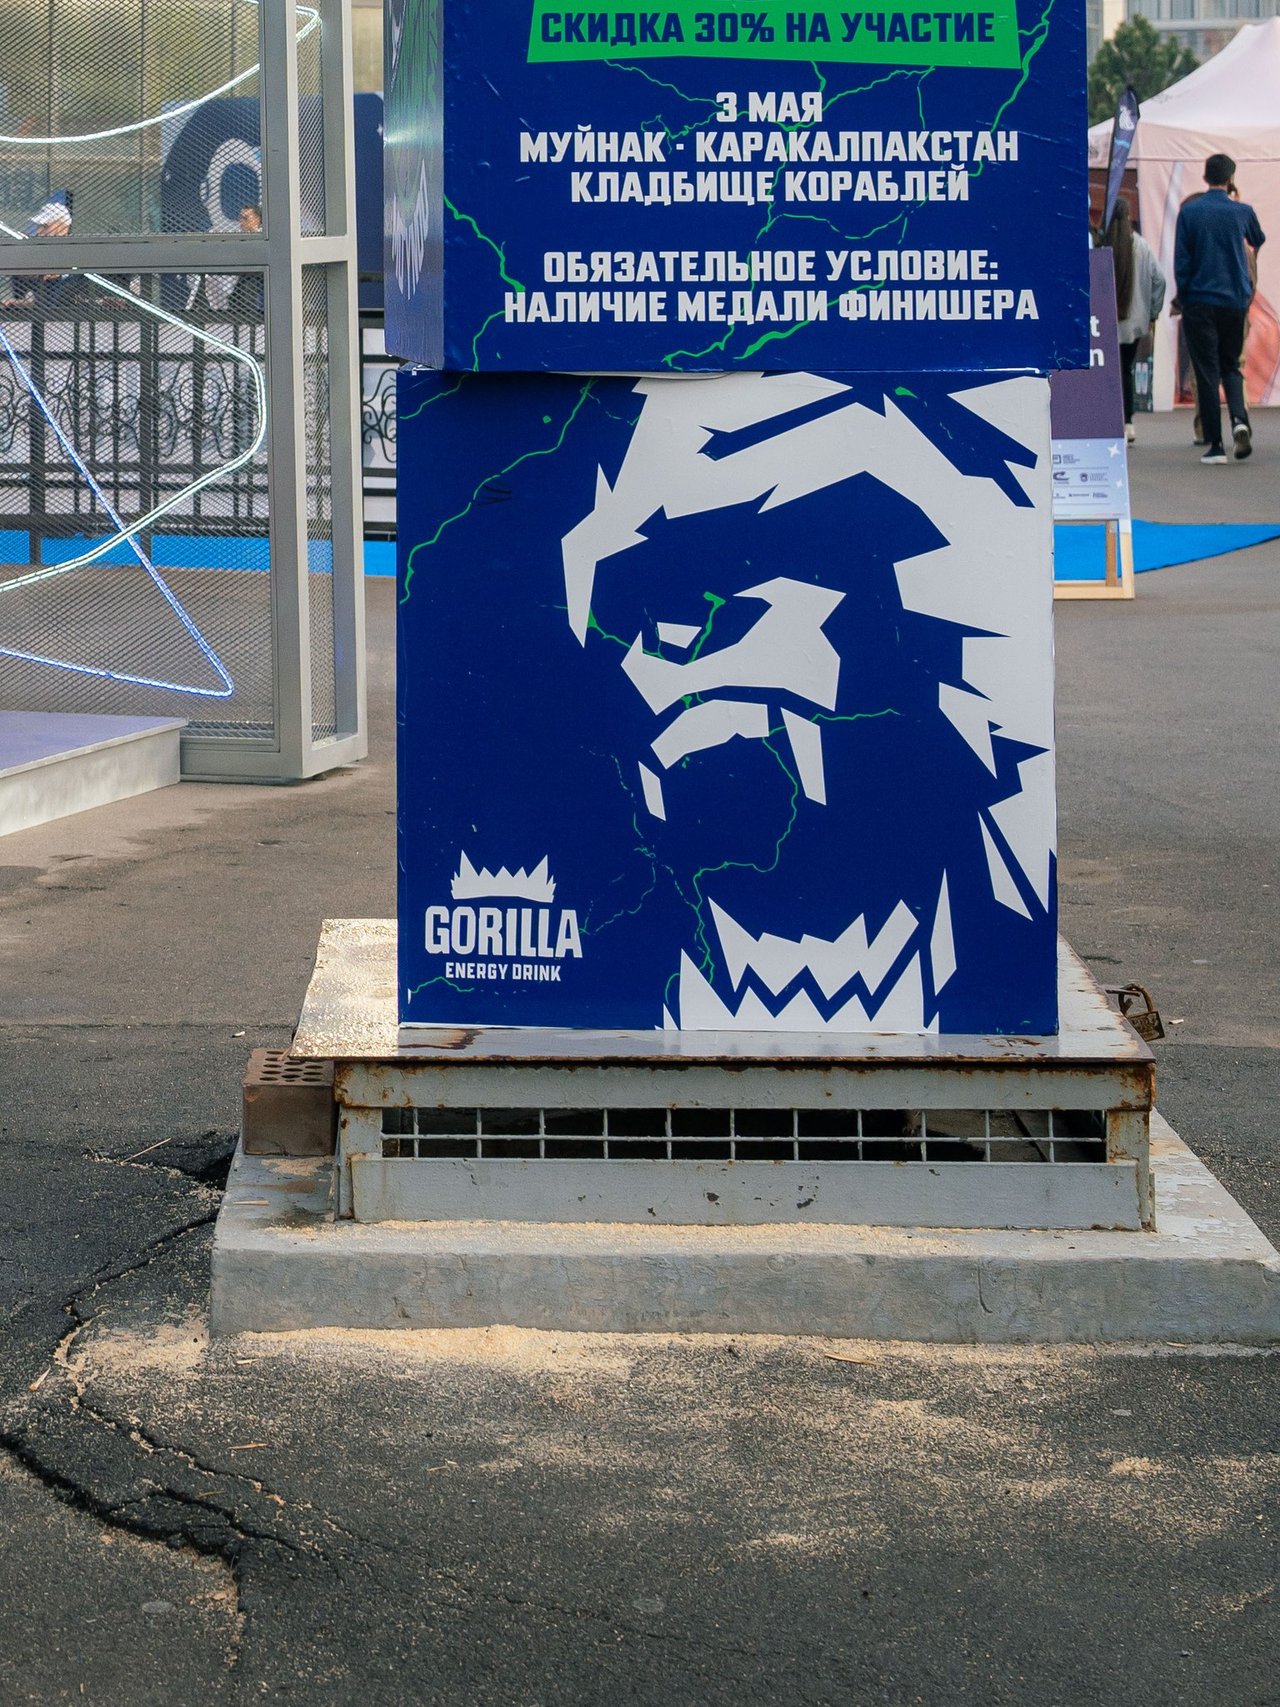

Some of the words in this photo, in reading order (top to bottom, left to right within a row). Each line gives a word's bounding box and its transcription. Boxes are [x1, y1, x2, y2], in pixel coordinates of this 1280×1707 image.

[540, 12, 685, 47] СКИДКА
[694, 12, 775, 43] 30%
[785, 12, 832, 43] НА
[840, 12, 996, 43] УЧАСТИЕ
[716, 92, 738, 123] 3
[748, 92, 823, 123] МАЯ
[520, 125, 666, 163] МУЙНАК
[695, 131, 1018, 162] КАРАКАЛПАКСТАН
[571, 172, 775, 206] КЛАДБИЩЕ
[785, 165, 969, 202] КОРАБЛЕЙ
[543, 251, 816, 283] ОБЯЗАТЕЛЬНОЕ
[825, 250, 998, 281] УСЛОВИЕ:
[504, 292, 667, 323] НАЛИЧИЕ
[677, 291, 828, 325] МЕДАЛИ
[838, 290, 1040, 321] ФИНИШЕРА
[425, 905, 583, 959] GORILLA
[445, 962, 508, 980] ENERGY
[512, 963, 561, 982] DRINK
